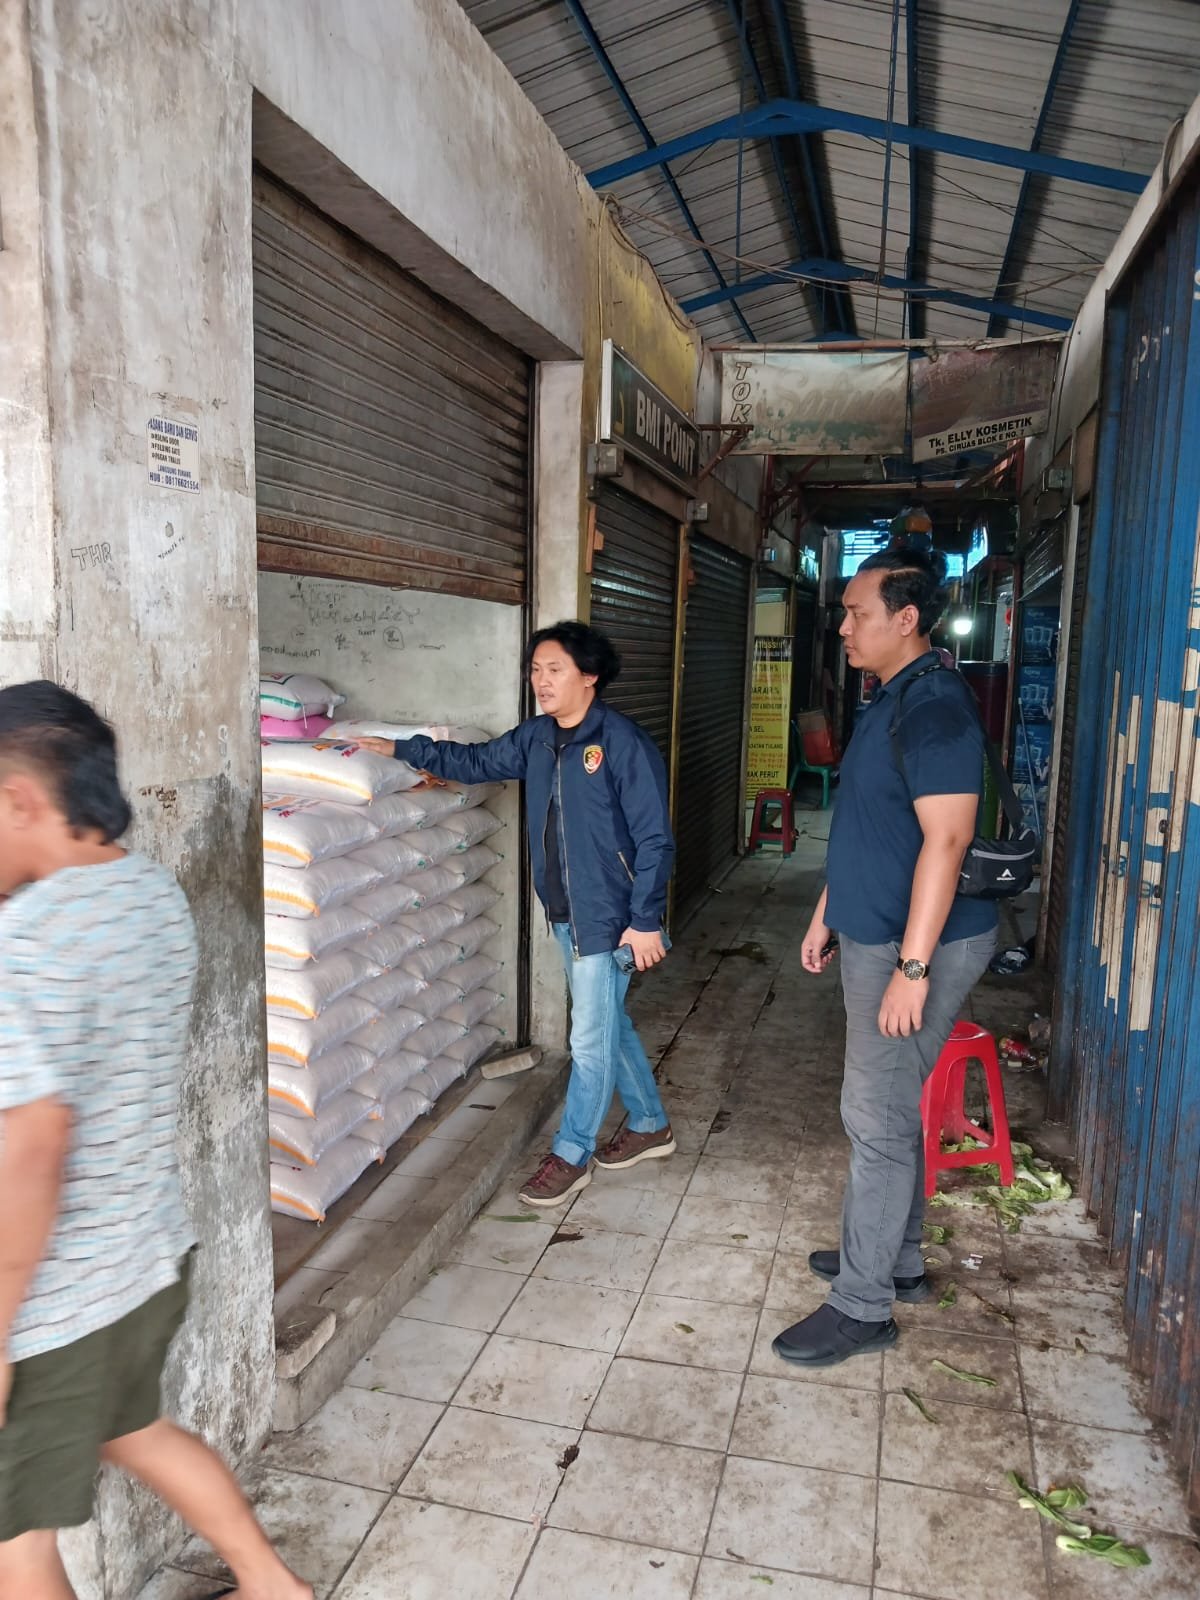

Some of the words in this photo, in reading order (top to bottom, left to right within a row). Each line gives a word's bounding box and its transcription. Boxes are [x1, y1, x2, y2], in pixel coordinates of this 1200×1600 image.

[729, 361, 752, 434] TOK
[184, 428, 198, 443] SERVIS
[636, 388, 660, 450] BMI
[664, 413, 695, 476] POINT
[929, 437, 945, 449] Tk.
[948, 429, 973, 445] ELLY
[976, 416, 1032, 438] KOSMETIK
[949, 441, 976, 452] CIRUAS
[977, 435, 996, 446] BLOK
